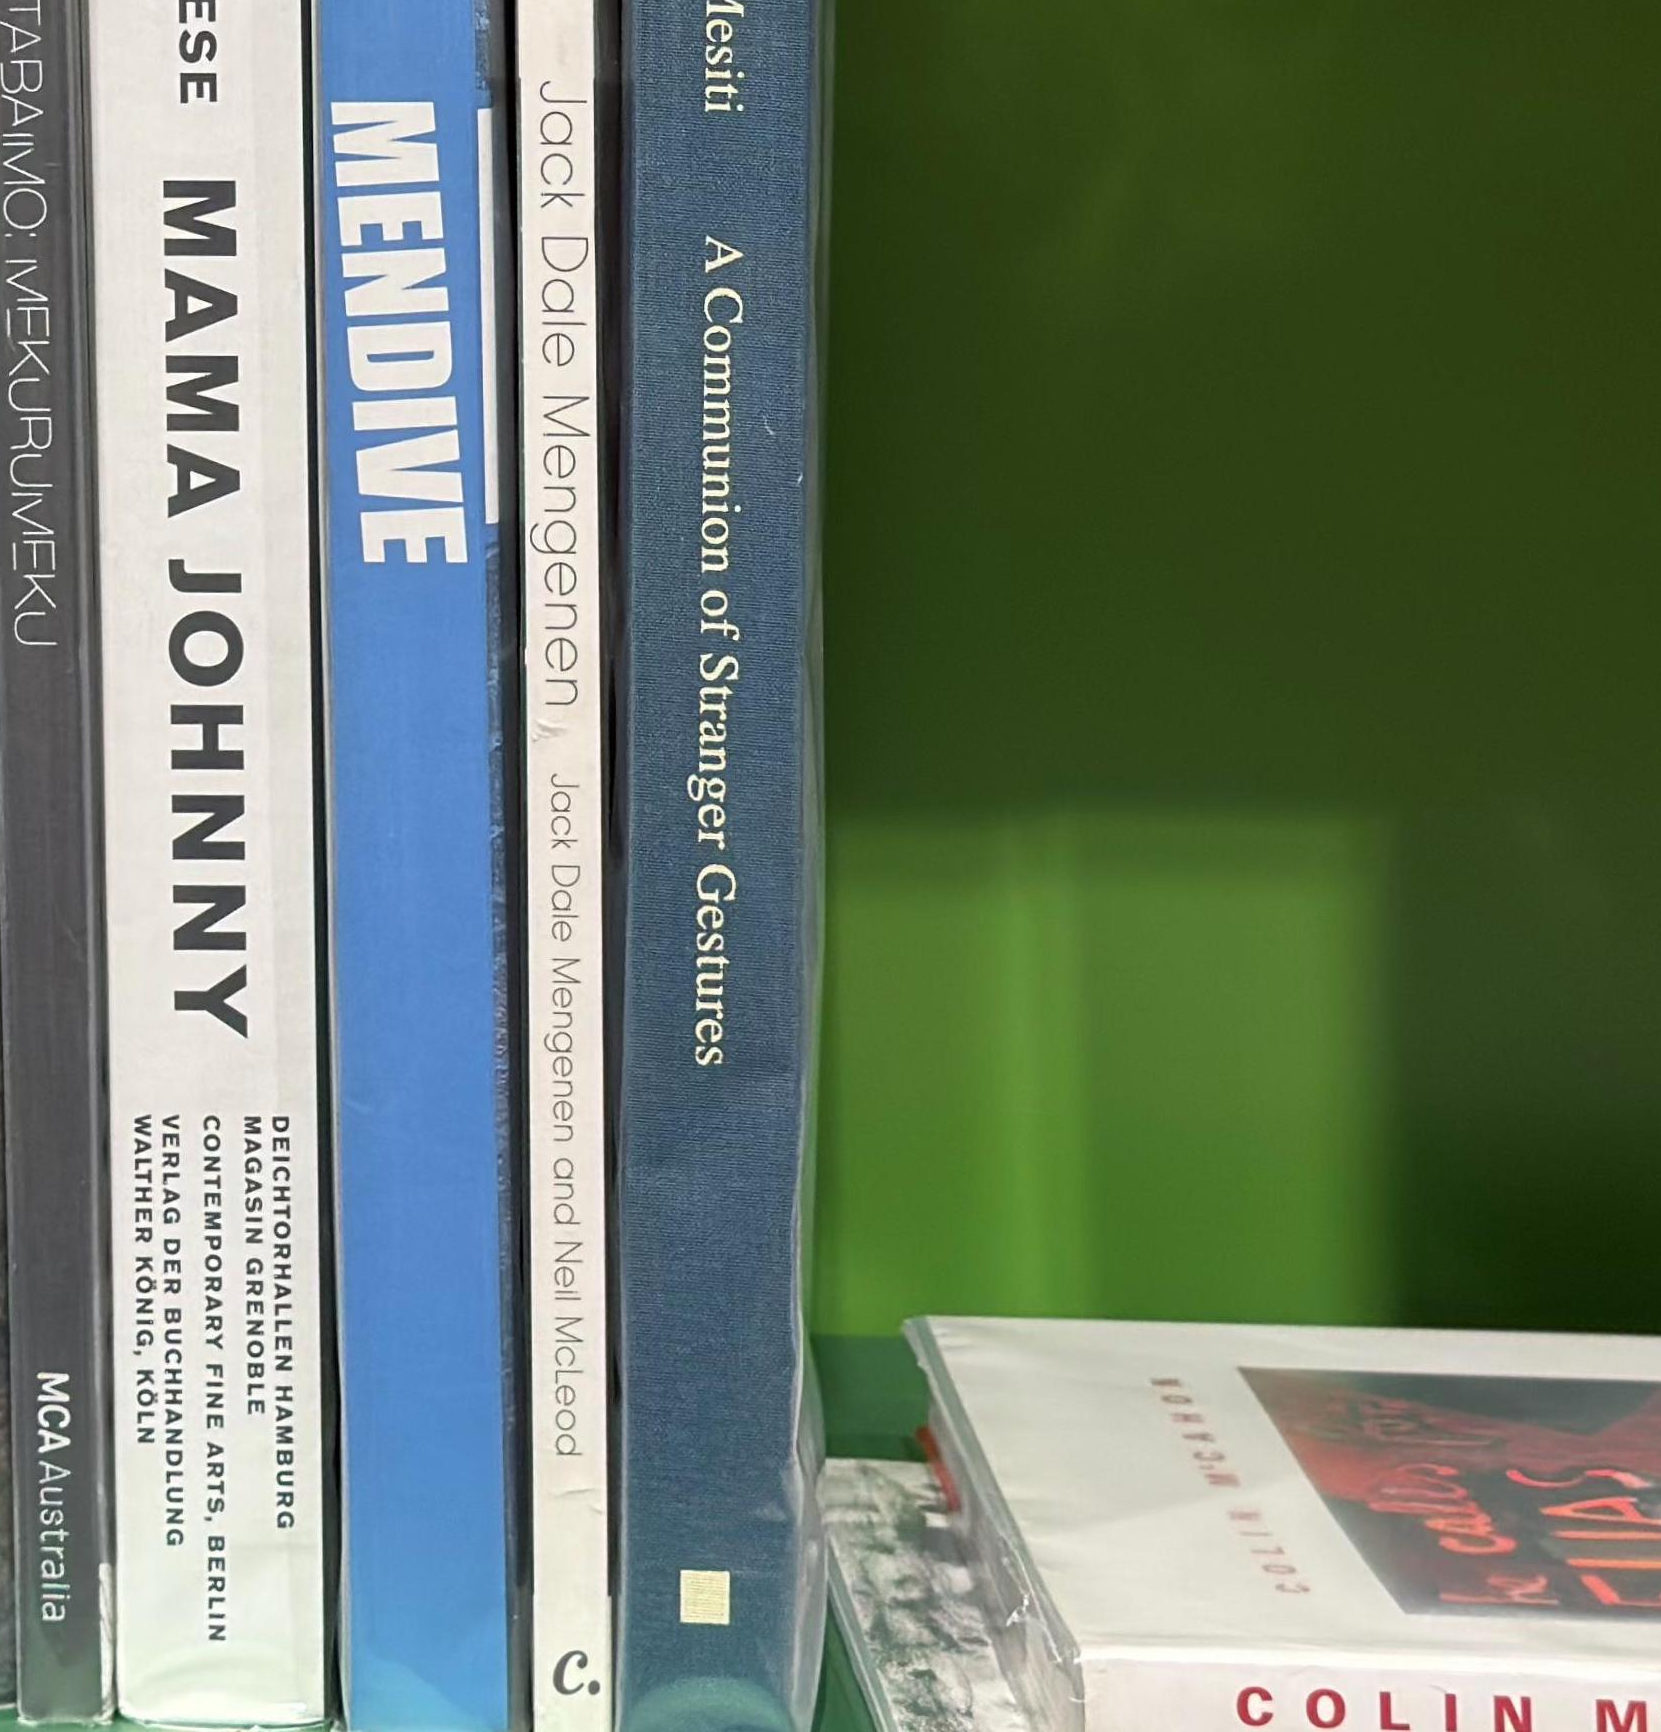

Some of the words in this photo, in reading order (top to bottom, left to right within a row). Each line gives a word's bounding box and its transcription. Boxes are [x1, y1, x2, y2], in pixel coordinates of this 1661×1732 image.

[539, 81, 587, 208] Jack
[541, 237, 588, 367] Dale
[705, 236, 743, 273] A
[163, 180, 240, 518] MAMA
[331, 102, 468, 563] MENDIVE
[701, 288, 743, 573] Communion
[530, 396, 590, 705] Mengenen
[700, 590, 739, 641] of
[168, 559, 247, 1038] JOHNNY
[551, 773, 580, 849] Jack
[691, 653, 739, 850] Stranger
[551, 865, 581, 942] Dale
[695, 864, 736, 1065] Gestures
[543, 958, 582, 1141] Mengenen
[134, 1115, 153, 1242] WALTHER
[162, 1115, 180, 1224] VERLAG
[203, 1115, 223, 1349] CONTEMPORARY
[244, 1116, 263, 1243] MAGASIN
[553, 1158, 581, 1225] and
[134, 1257, 156, 1355] KÖNIG,
[163, 1239, 181, 1294] DER
[272, 1116, 292, 1371] DEICHTORHALLEN
[554, 1242, 584, 1300] Neil
[206, 1364, 223, 1428] FINE
[246, 1258, 265, 1414] GRENOBLE
[554, 1317, 584, 1456] McLeod
[36, 1372, 71, 1453] MCA
[137, 1370, 157, 1443] KÖLN
[164, 1308, 184, 1545] BUCHHANDLUNG
[276, 1386, 294, 1528] HAMBURG
[39, 1461, 71, 1621] Australia
[204, 1442, 224, 1521] ARTS,
[208, 1536, 226, 1641] BERLIN
[1228, 1511, 1311, 1592] COLIN
[1236, 1685, 1532, 1732] COLIN
